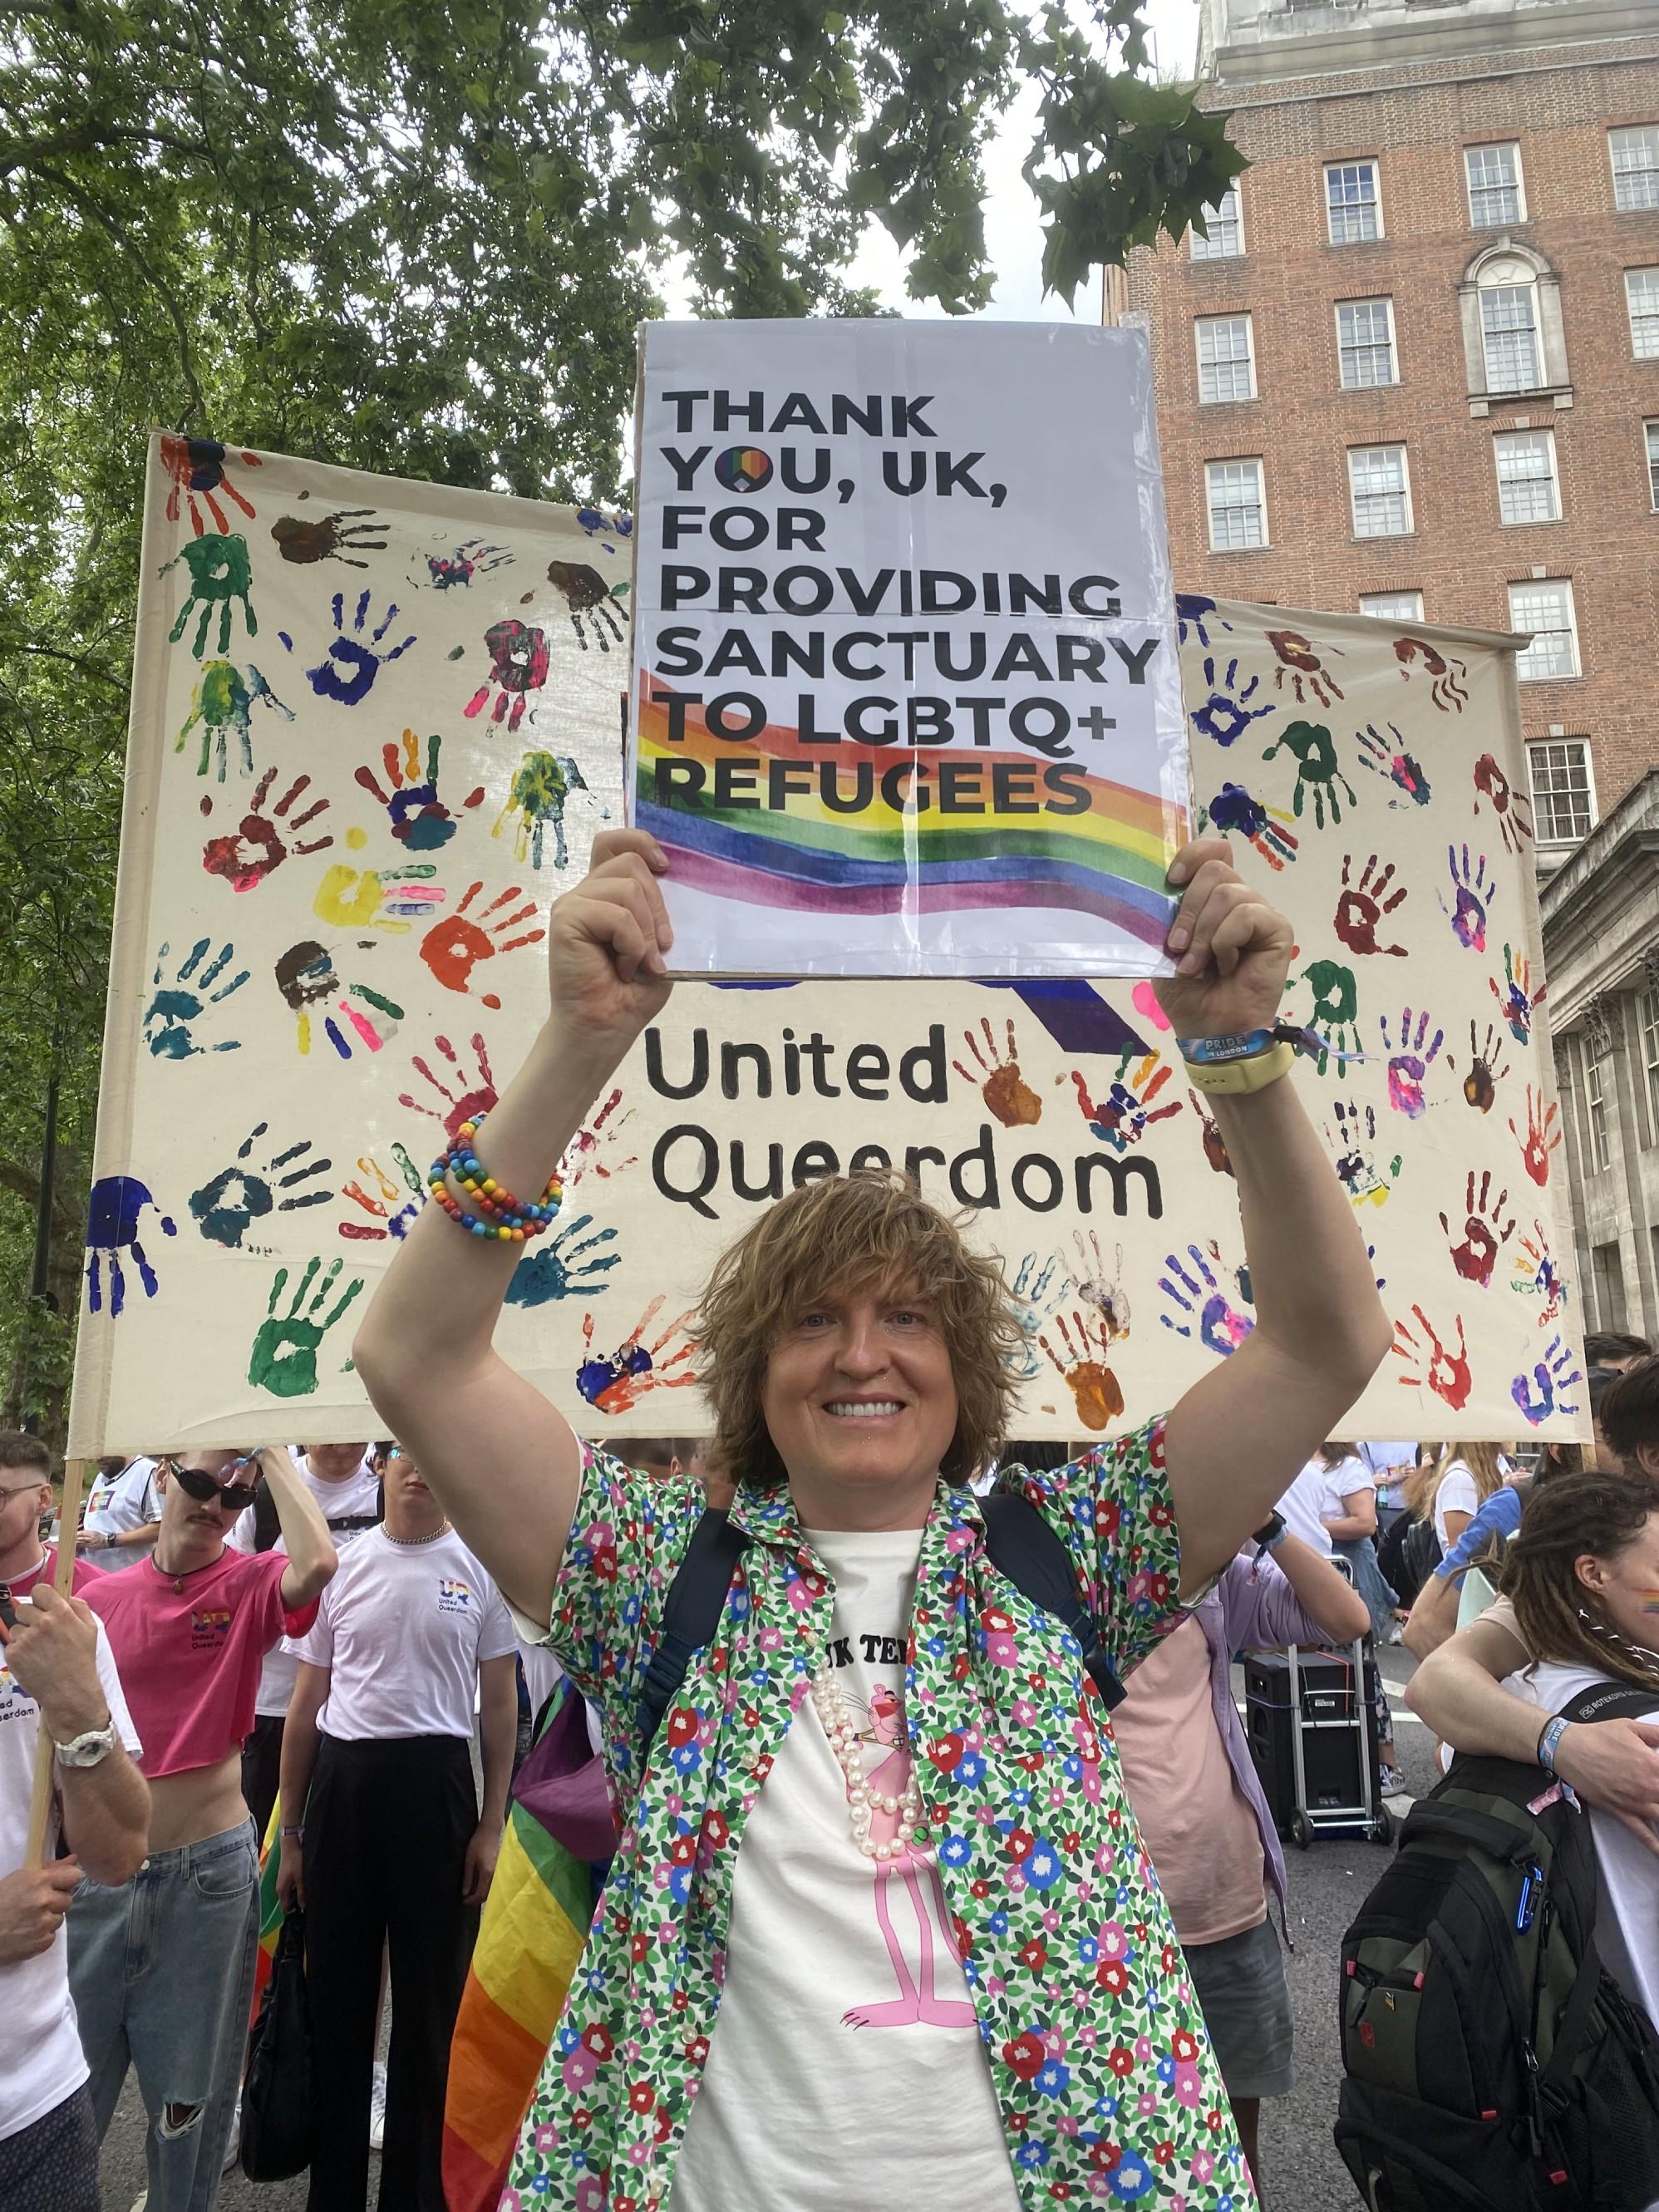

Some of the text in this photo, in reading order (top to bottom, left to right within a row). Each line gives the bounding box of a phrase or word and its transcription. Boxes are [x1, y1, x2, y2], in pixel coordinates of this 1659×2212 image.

[662, 390, 938, 437] THANK
[661, 446, 1008, 508] YOU, UK,
[662, 505, 826, 552] FOR
[661, 564, 1122, 618] PROVIDING
[655, 627, 1161, 686] SANCTUARY
[652, 691, 1117, 758] TO LGBTQ+
[655, 757, 1094, 815] REFUGEES
[644, 1023, 949, 1104] United
[1205, 1034, 1245, 1051] PRIDE
[1216, 1046, 1248, 1057] LONDON
[652, 1123, 1163, 1219] Queerdom
[439, 1598, 457, 1606] United
[439, 1604, 468, 1614] Queerdom
[191, 1633, 215, 1641] United
[1551, 1721, 1568, 1742] PRIDE
